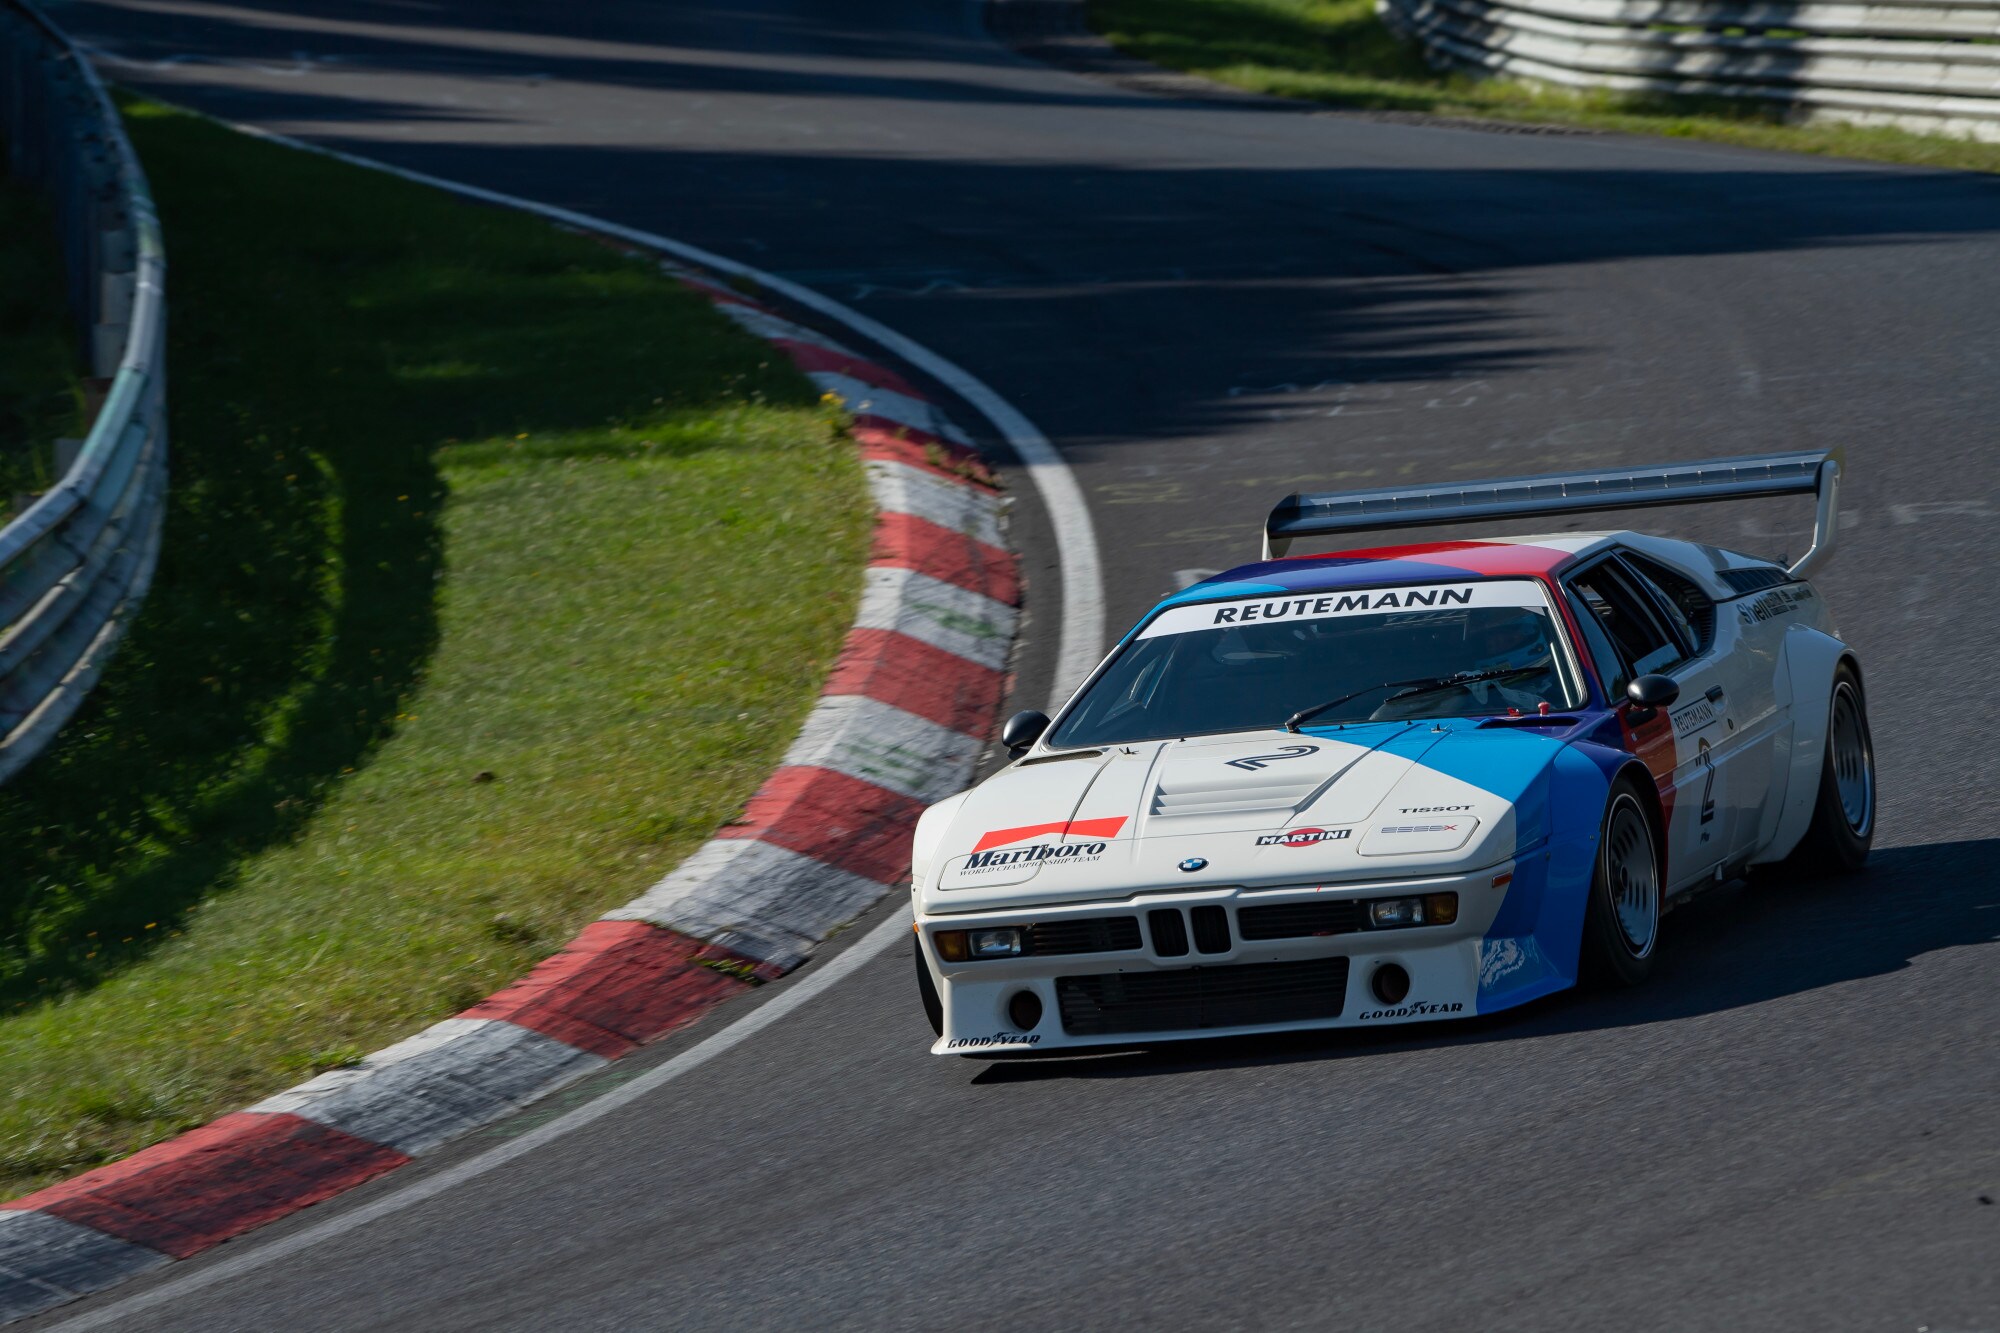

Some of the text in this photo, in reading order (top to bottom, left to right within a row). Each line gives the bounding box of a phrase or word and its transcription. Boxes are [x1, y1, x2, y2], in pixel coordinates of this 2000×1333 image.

[1213, 588, 1473, 624] REUTEMANN
[1736, 597, 1773, 625] Shell
[1674, 702, 1713, 734] REUTEMANN
[1223, 745, 1320, 771] 2
[1695, 736, 1715, 826] 2
[1399, 805, 1475, 814] TISSOT
[1260, 830, 1348, 845] MARTINI
[960, 855, 1101, 876] WORLD CHAMPIONSHIP TEAM
[963, 842, 1106, 870] Marlboro
